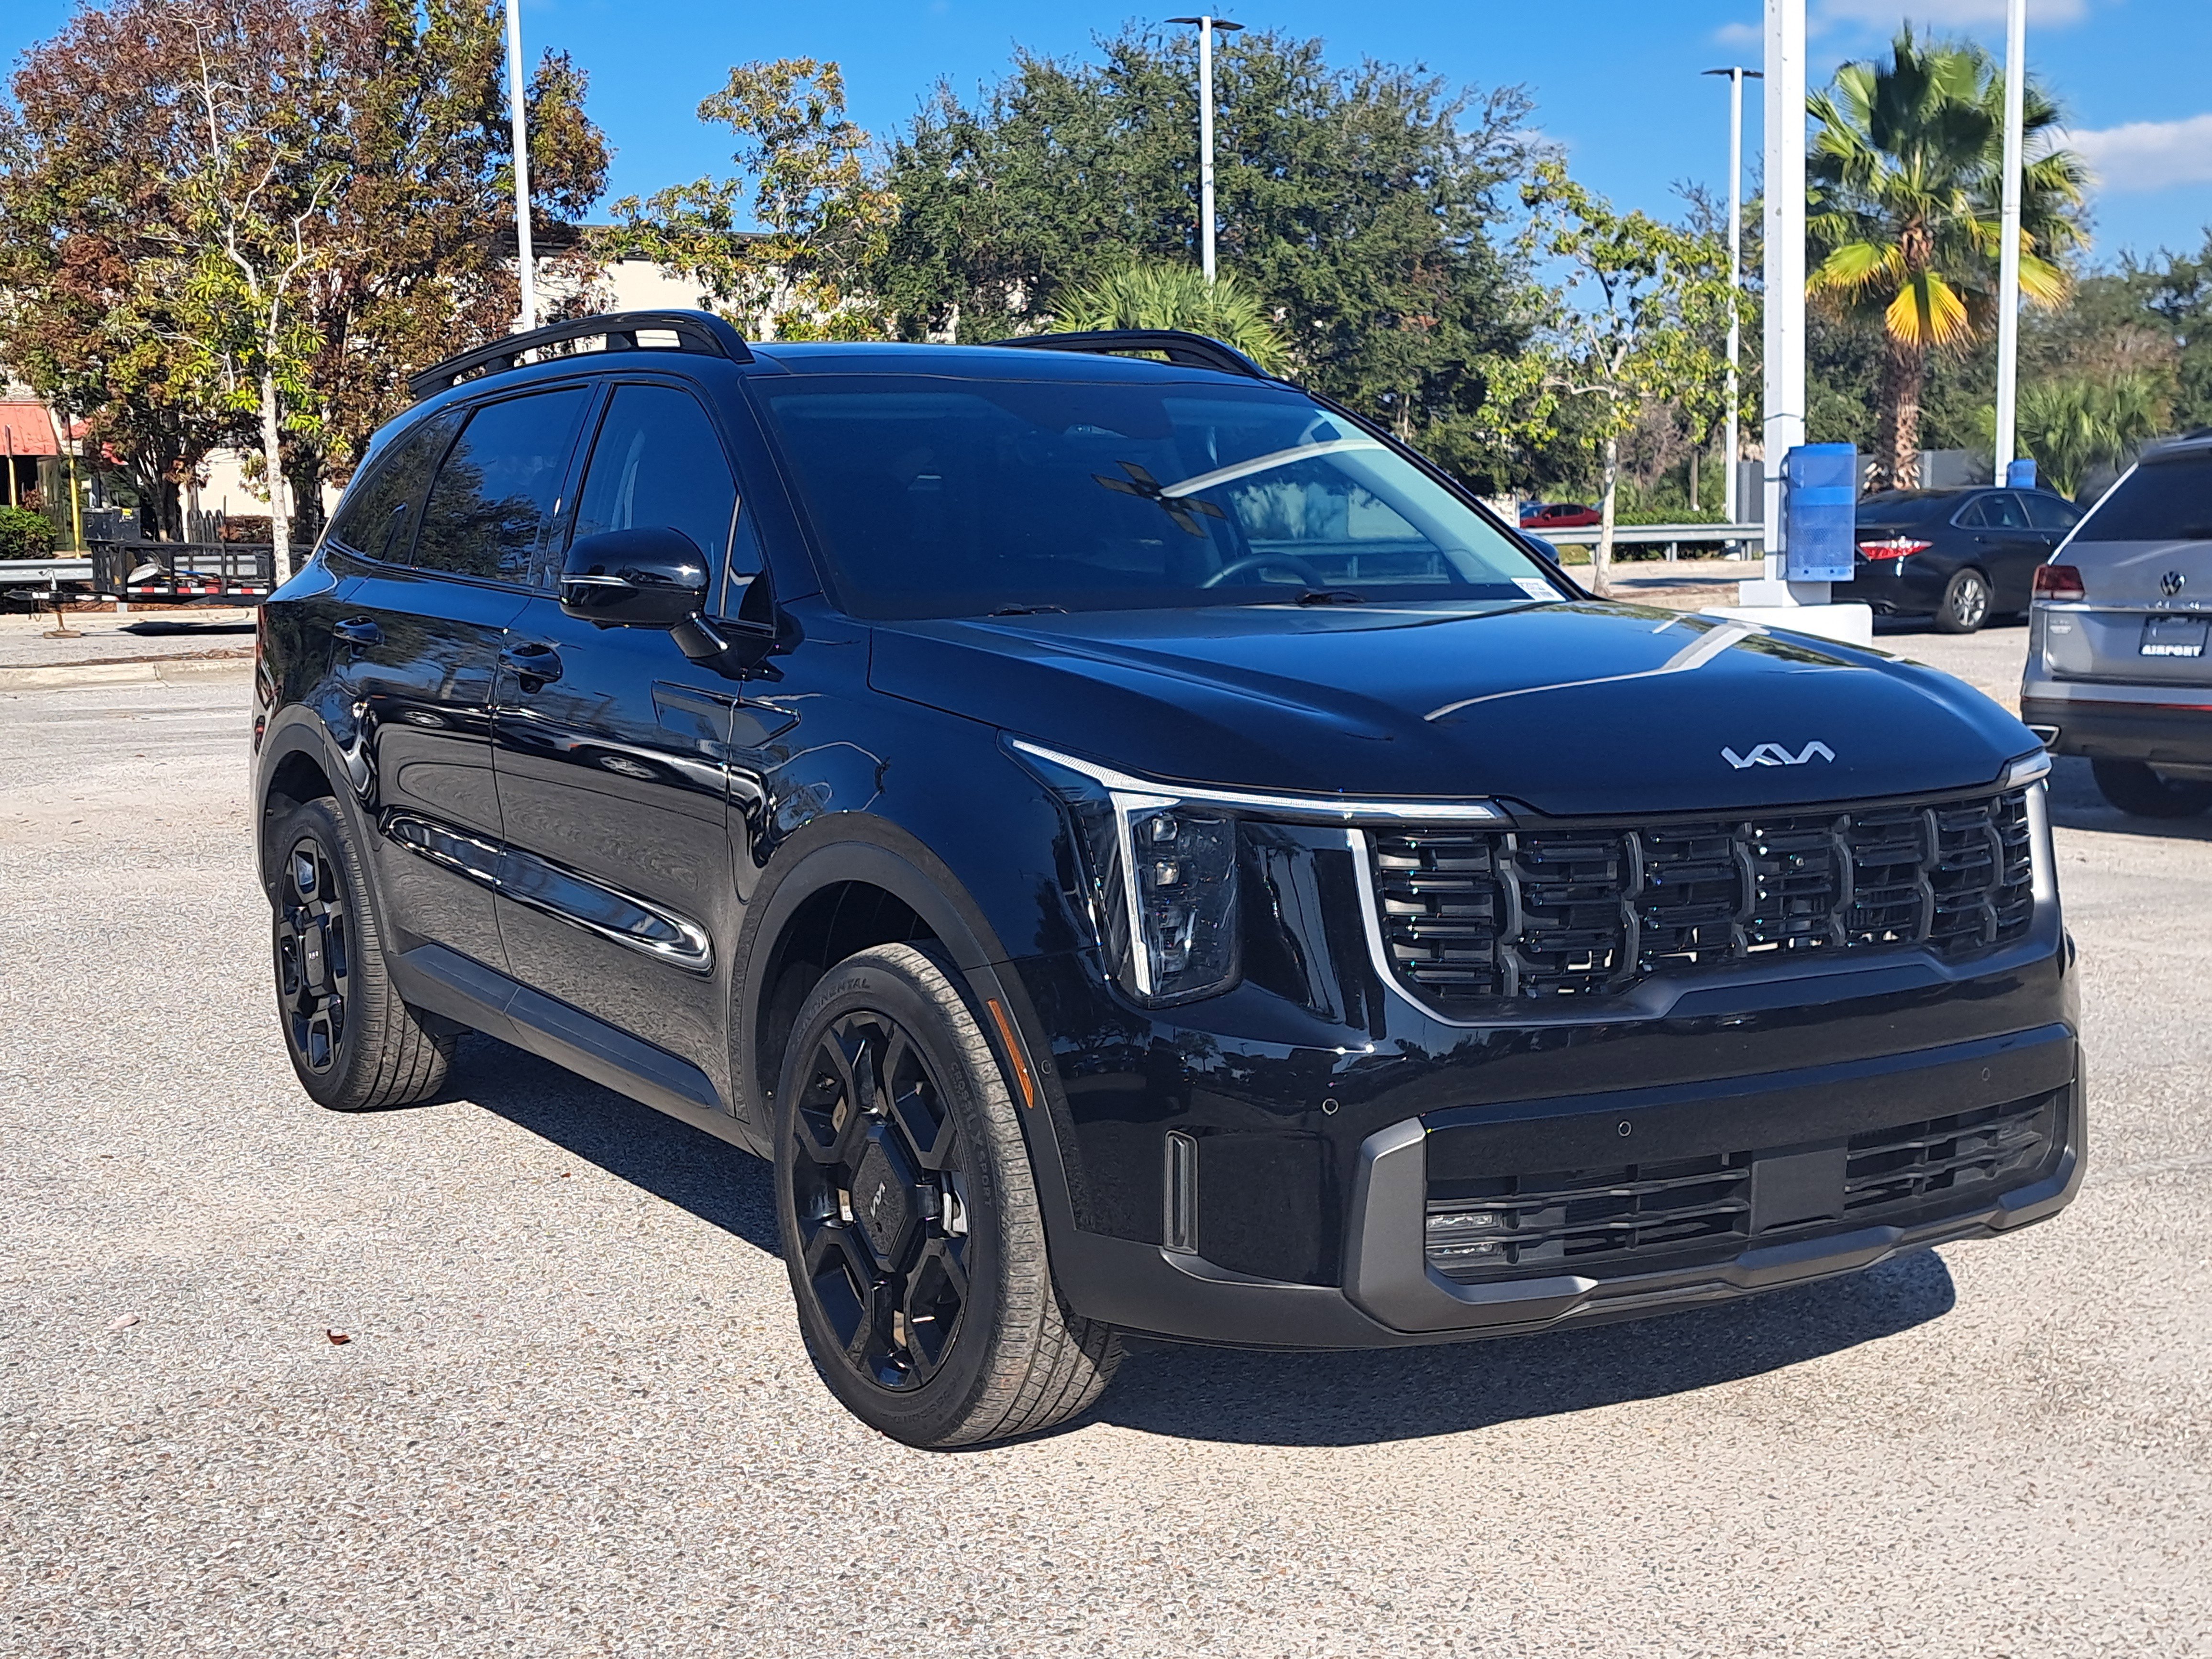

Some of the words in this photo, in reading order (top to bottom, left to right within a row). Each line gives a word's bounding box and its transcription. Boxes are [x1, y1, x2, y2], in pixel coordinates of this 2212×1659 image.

[2140, 644, 2202, 657] AIRPORT
[1721, 741, 1836, 769] KIA
[978, 1150, 992, 1208] SPORT
